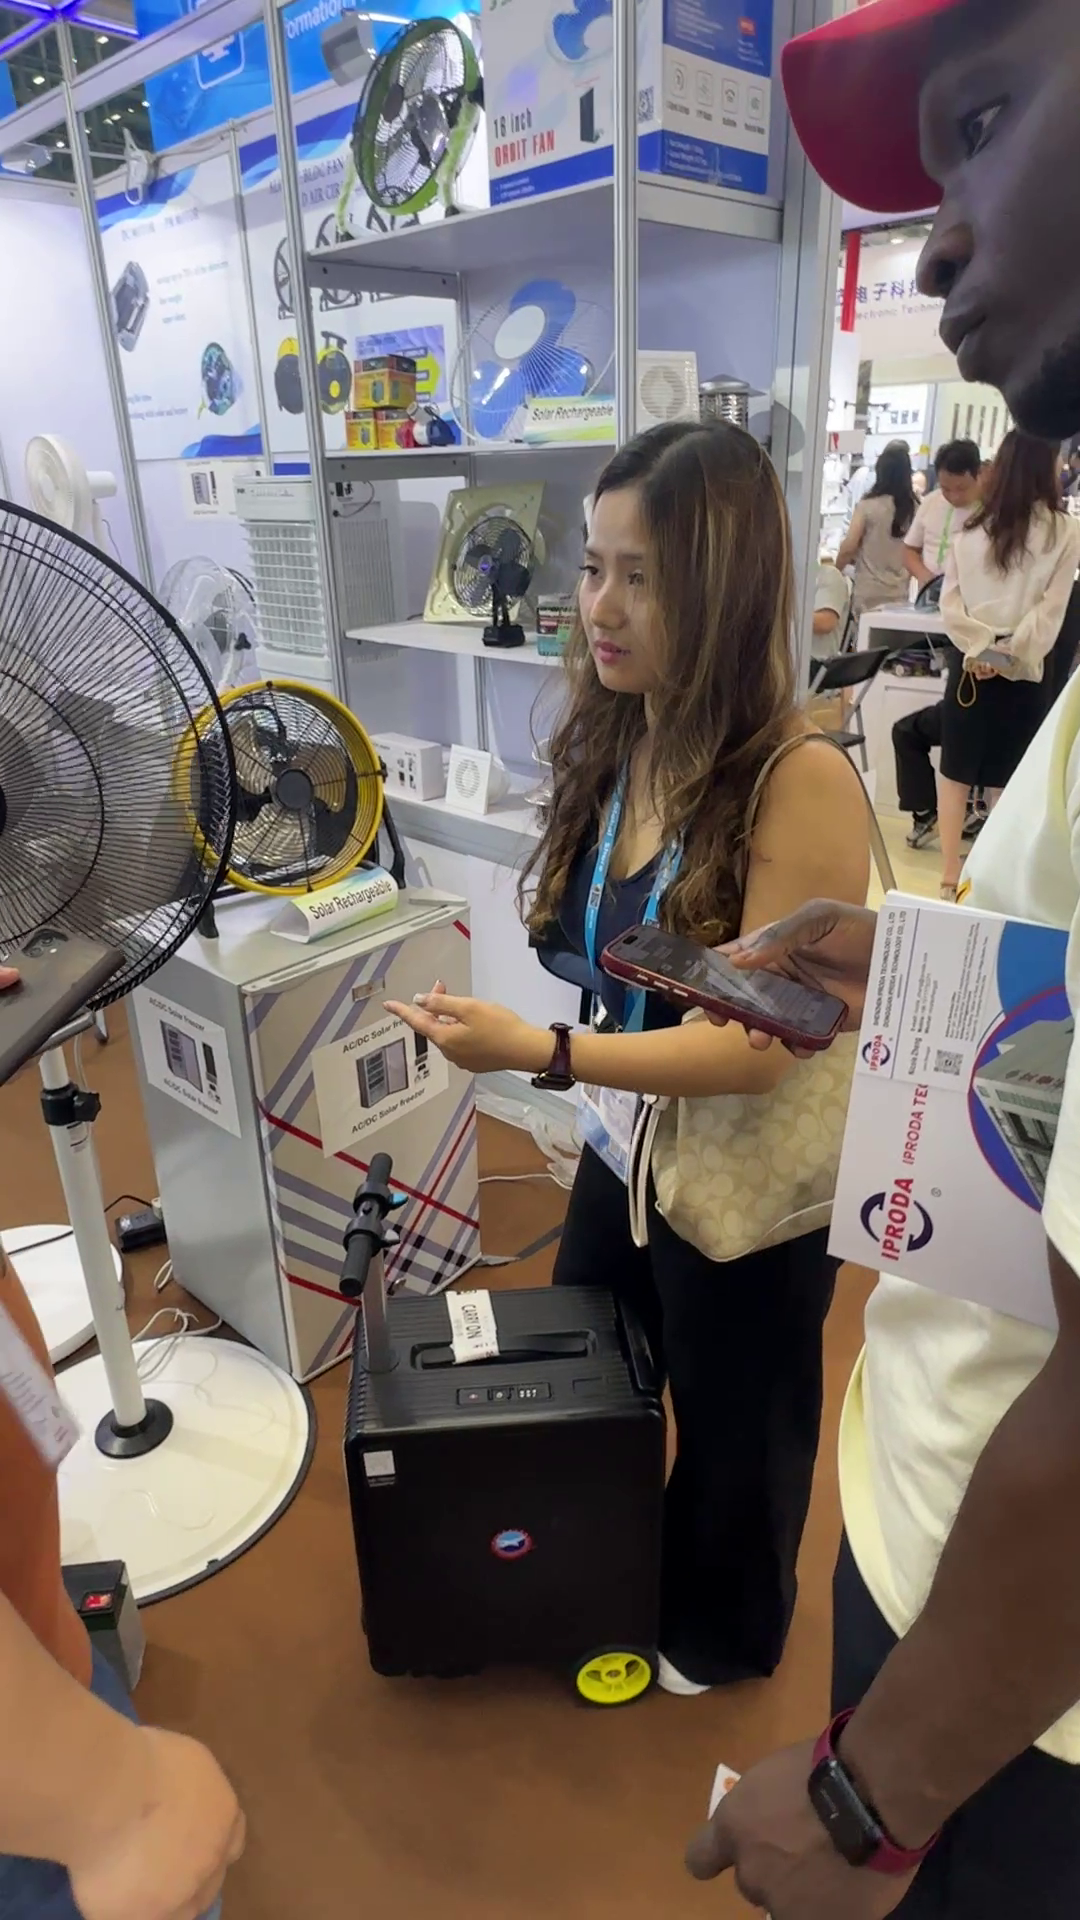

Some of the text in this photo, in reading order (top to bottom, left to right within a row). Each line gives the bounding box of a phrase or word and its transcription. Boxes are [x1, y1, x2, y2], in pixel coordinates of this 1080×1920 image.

[511, 107, 532, 133] inch
[494, 129, 555, 168] ORBIT FAN
[532, 405, 614, 421] Solar Rechargeable
[309, 880, 392, 919] Solar Rechargeable
[880, 937, 892, 975] TECHNOLOGY
[342, 1032, 370, 1054] AC/DC
[371, 1024, 392, 1039] Solar
[869, 1034, 883, 1071] IPRODA
[351, 1114, 378, 1134] AC/DC
[379, 1103, 399, 1119] Solar
[902, 1111, 924, 1166] IPRODA
[880, 1177, 914, 1262] IPRODA
[461, 1303, 482, 1340] CARRY ON
